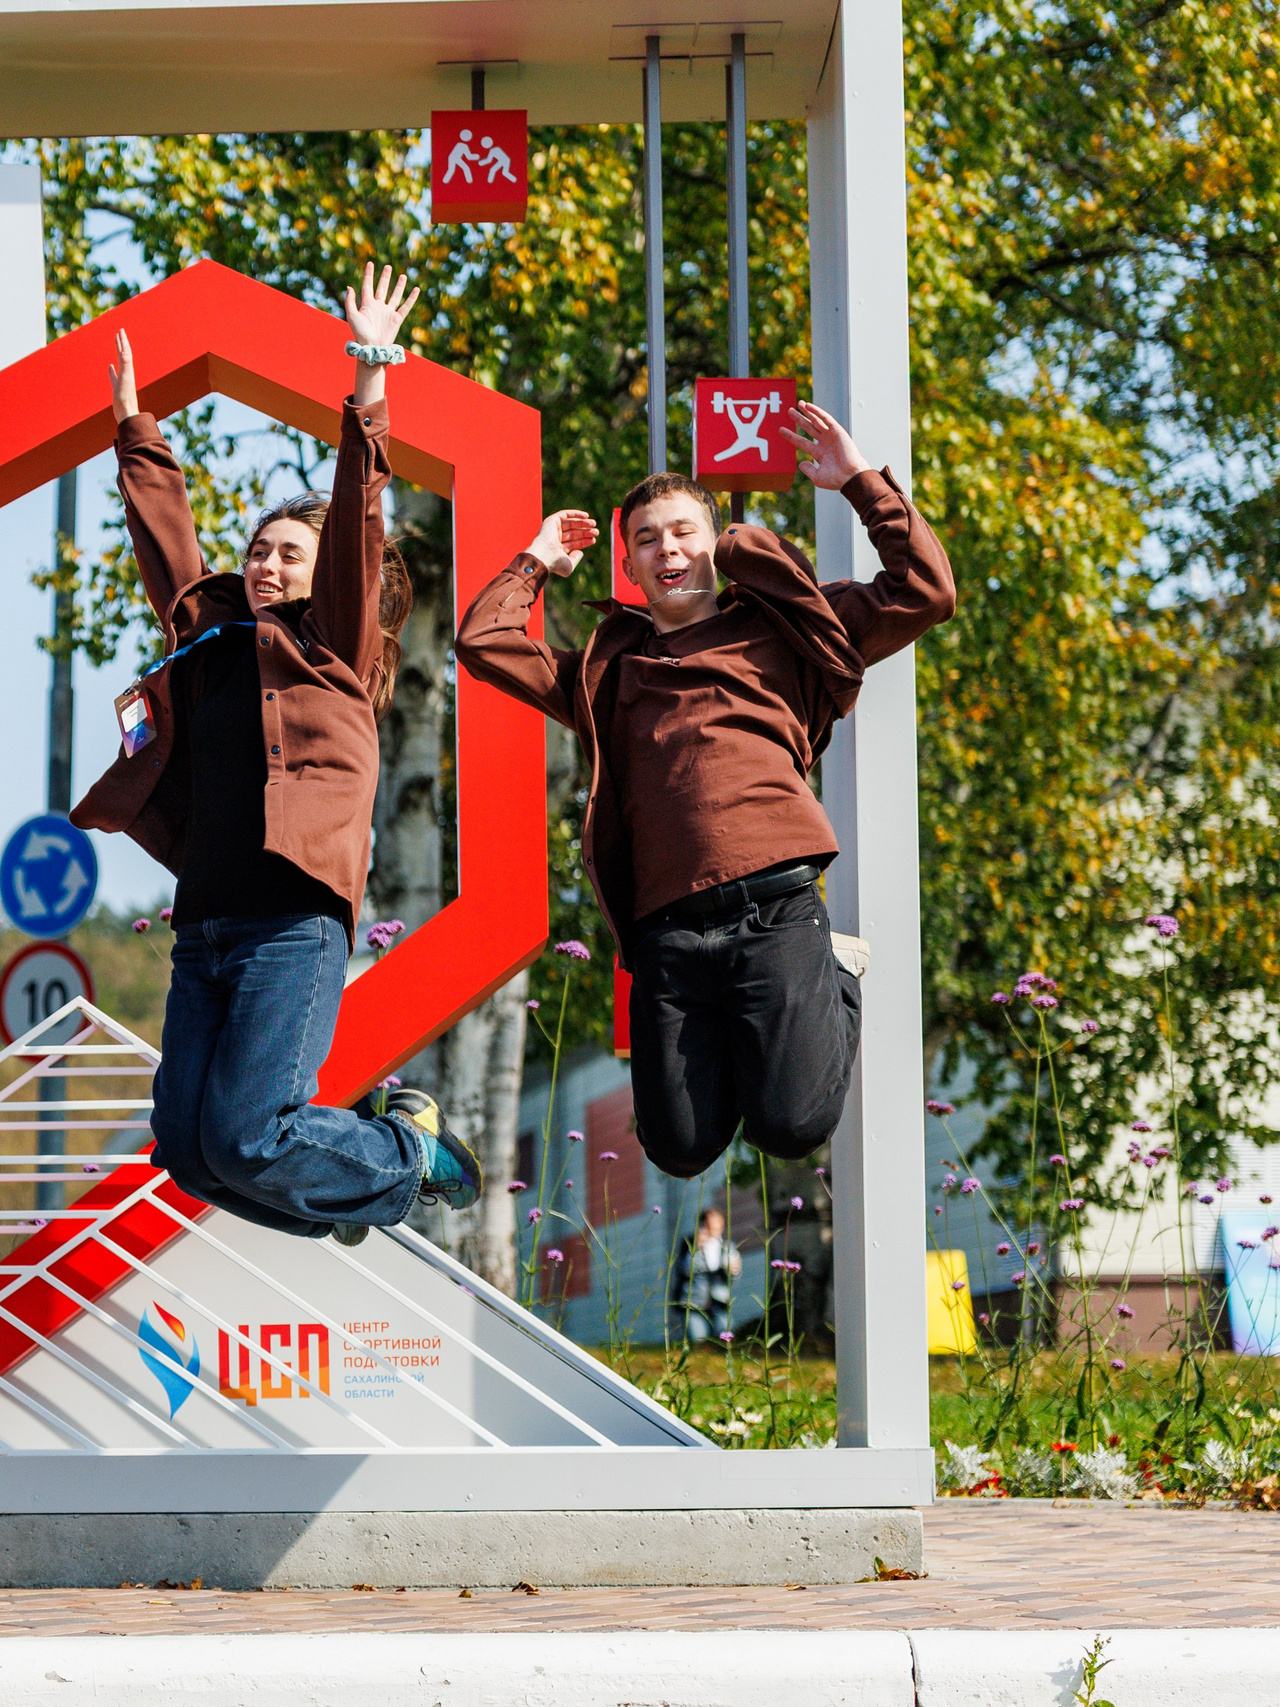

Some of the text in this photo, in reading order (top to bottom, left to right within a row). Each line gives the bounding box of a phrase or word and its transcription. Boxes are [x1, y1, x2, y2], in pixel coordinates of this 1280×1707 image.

[23, 979, 68, 1026] 10
[342, 1321, 390, 1335] ЦЕНТР
[343, 1334, 442, 1351] СОРТИВНОЙ
[344, 1388, 395, 1399] ОБЛАСТИ
